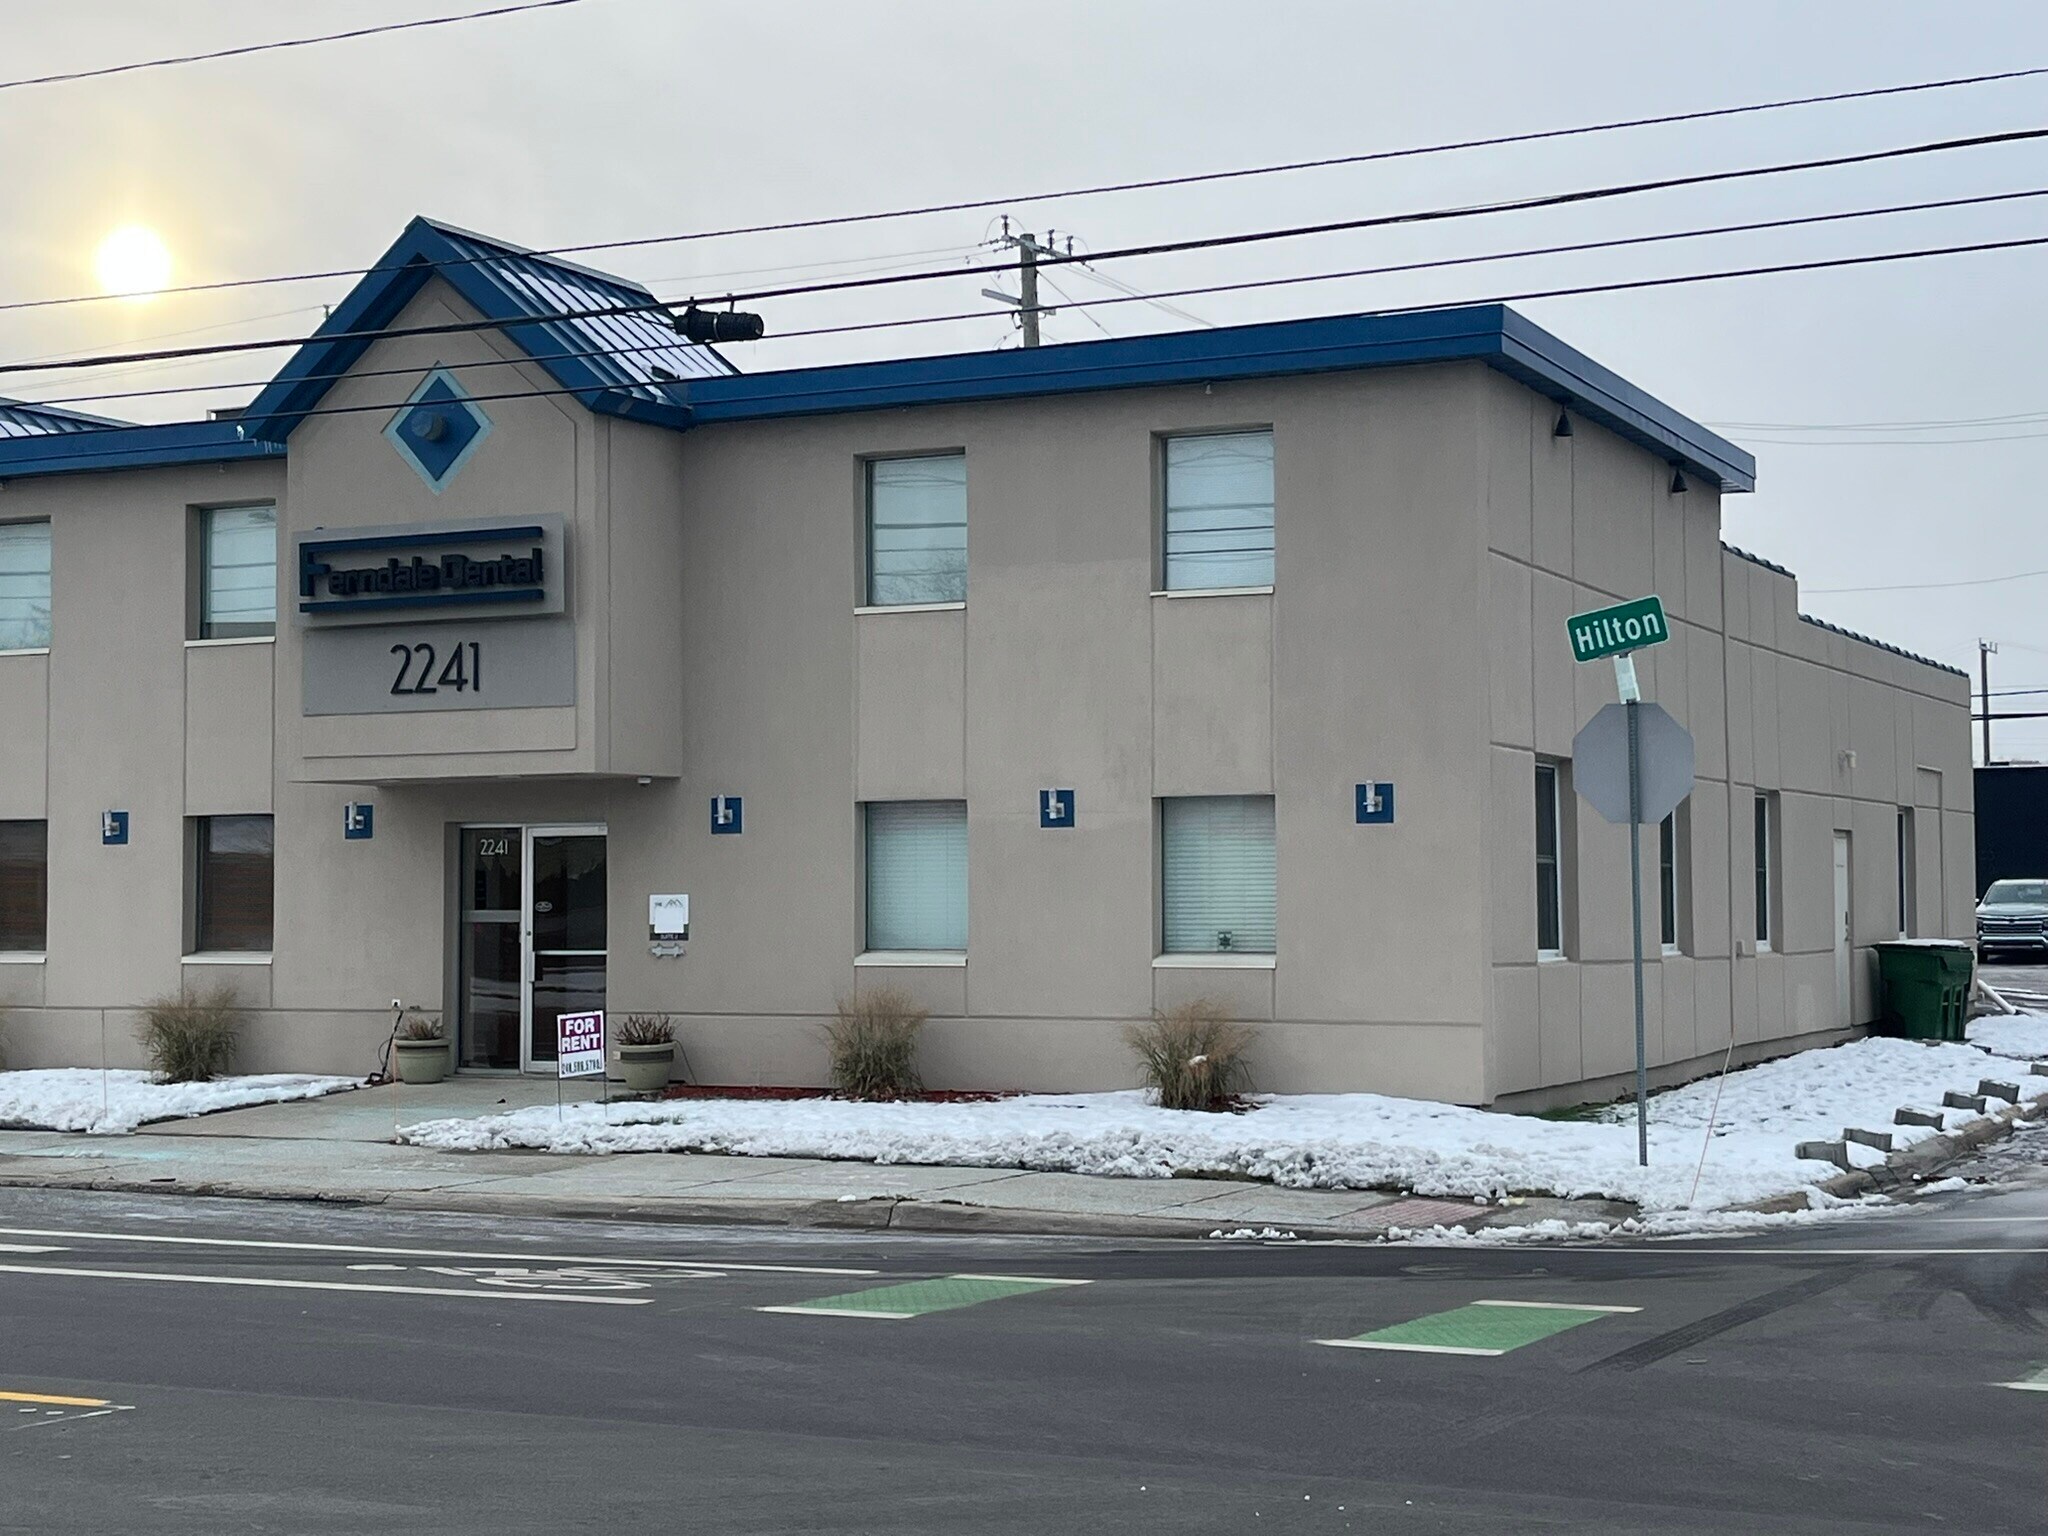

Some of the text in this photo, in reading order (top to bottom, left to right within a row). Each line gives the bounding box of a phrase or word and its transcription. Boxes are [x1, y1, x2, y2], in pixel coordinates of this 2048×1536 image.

[299, 542, 544, 596] Ferndale Dental
[1575, 612, 1660, 653] Hilton
[390, 641, 480, 694] 2241
[480, 838, 508, 855] 2241
[565, 1017, 595, 1035] FOR
[561, 1033, 600, 1052] RENT
